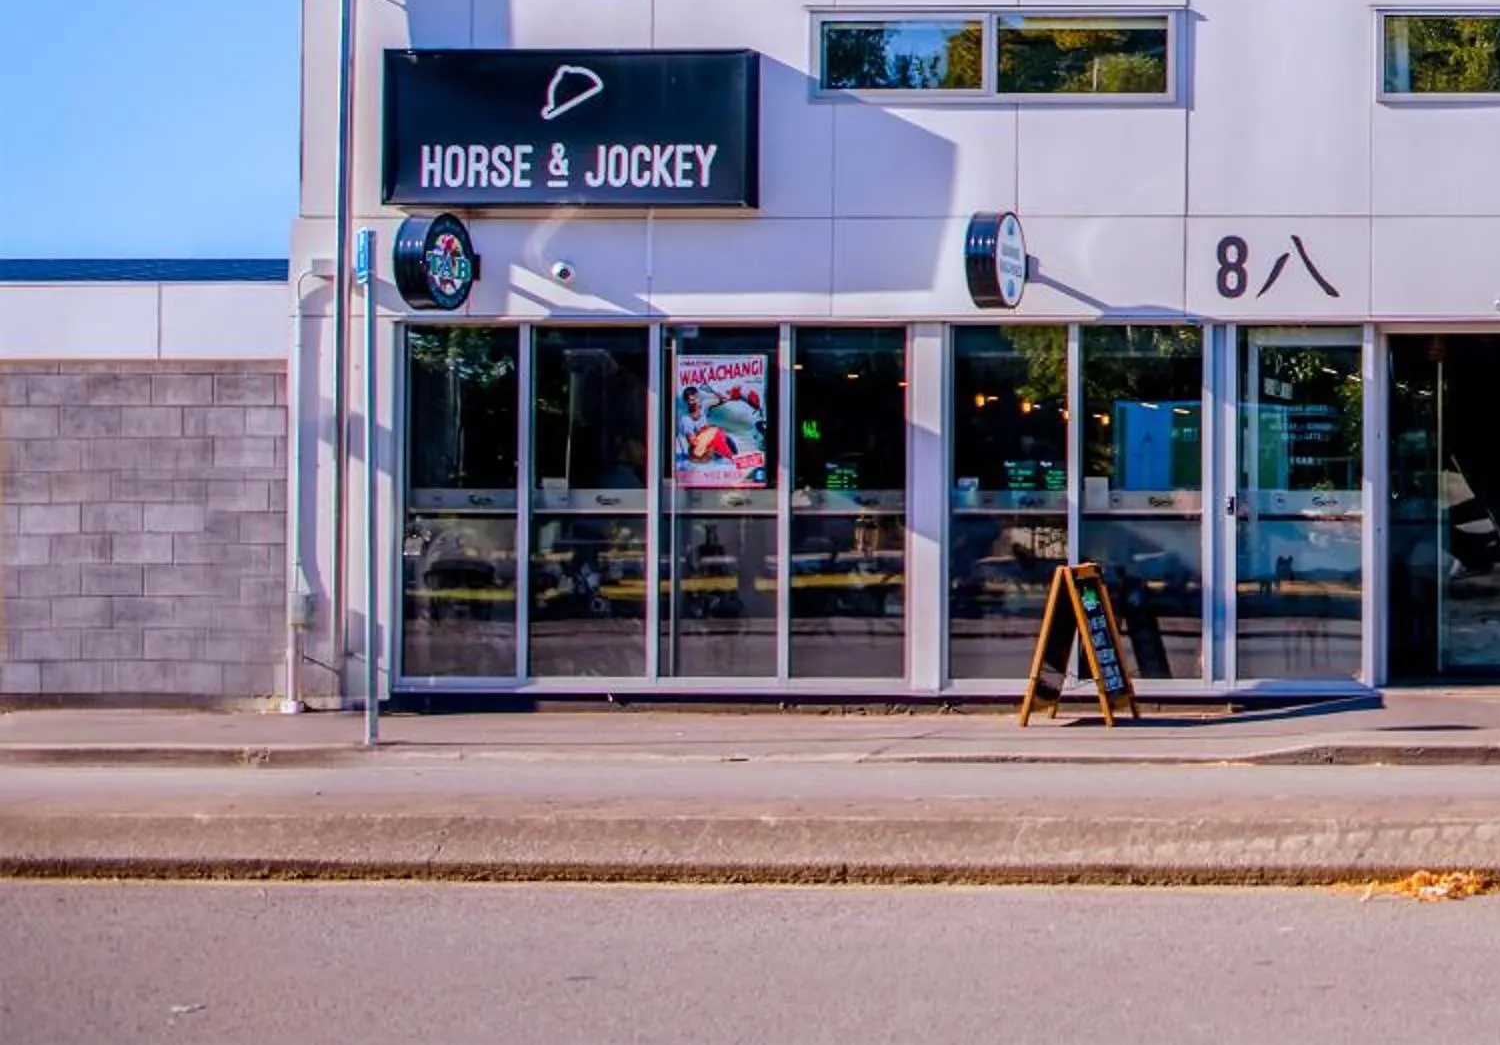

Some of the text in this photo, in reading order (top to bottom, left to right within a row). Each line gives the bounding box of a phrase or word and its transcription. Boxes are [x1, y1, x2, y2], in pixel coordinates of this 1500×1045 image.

[420, 142, 718, 188] HORSE & JOCKEY
[426, 251, 472, 282] TAB
[680, 359, 763, 386] WAKACHANGI
